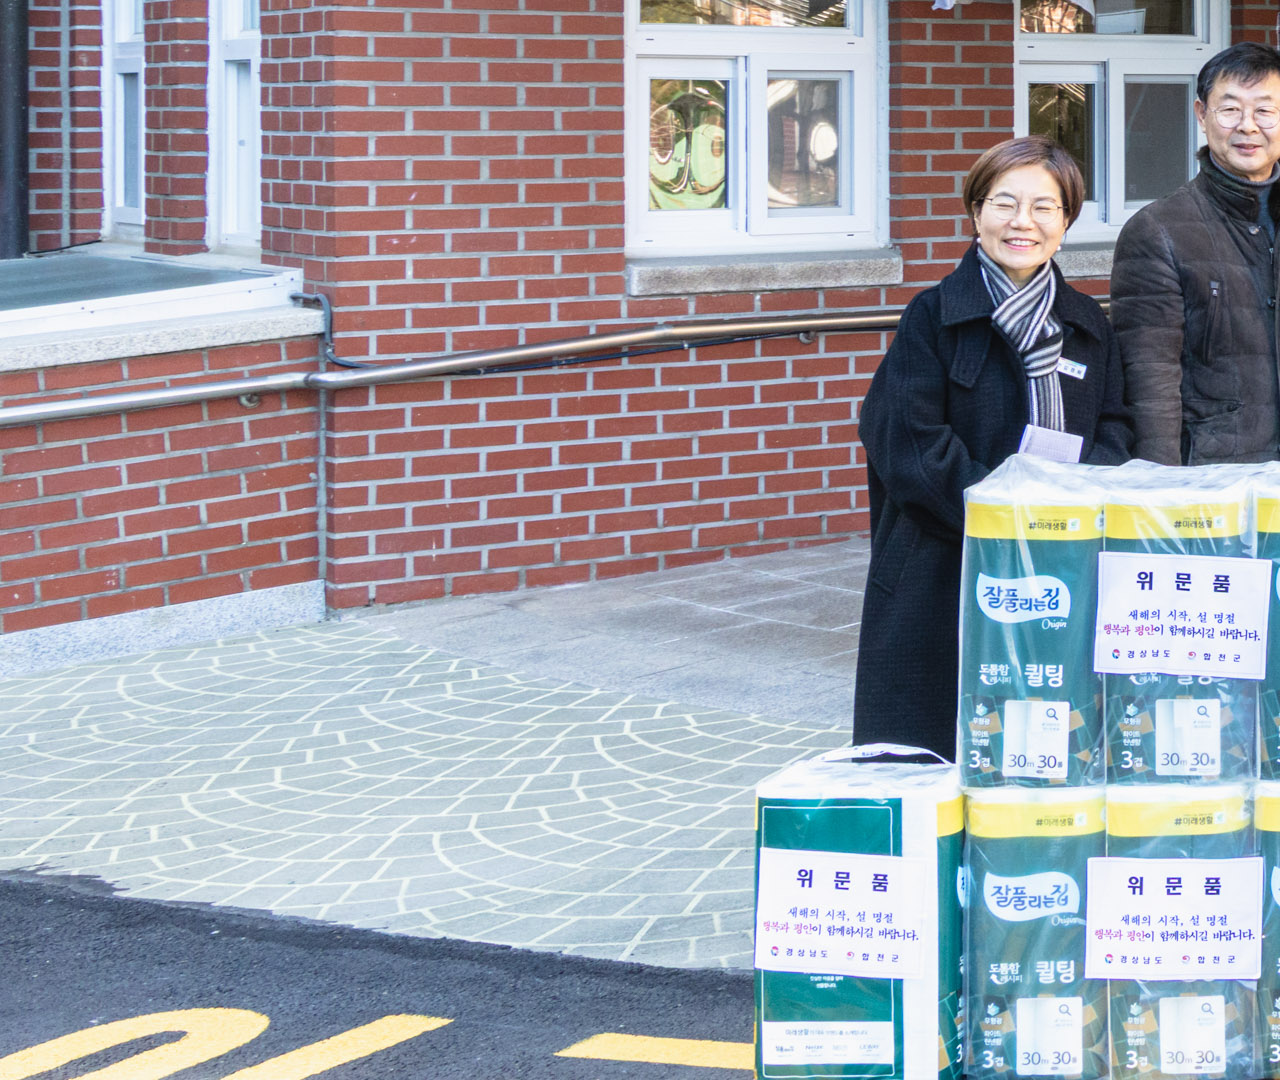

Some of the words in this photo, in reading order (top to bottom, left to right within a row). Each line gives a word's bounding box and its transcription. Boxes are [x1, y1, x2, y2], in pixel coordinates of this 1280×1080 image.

[982, 584, 1061, 613] 잘풀리는집
[1024, 663, 1064, 688] 퀼팅
[968, 750, 991, 769] 3겹
[1120, 750, 1144, 769] 3겹
[990, 882, 1069, 911] 잘풀리는집
[1035, 959, 1075, 983] 퀼팅
[981, 1050, 1004, 1069] 3겹
[1126, 1050, 1148, 1069] 3겹
